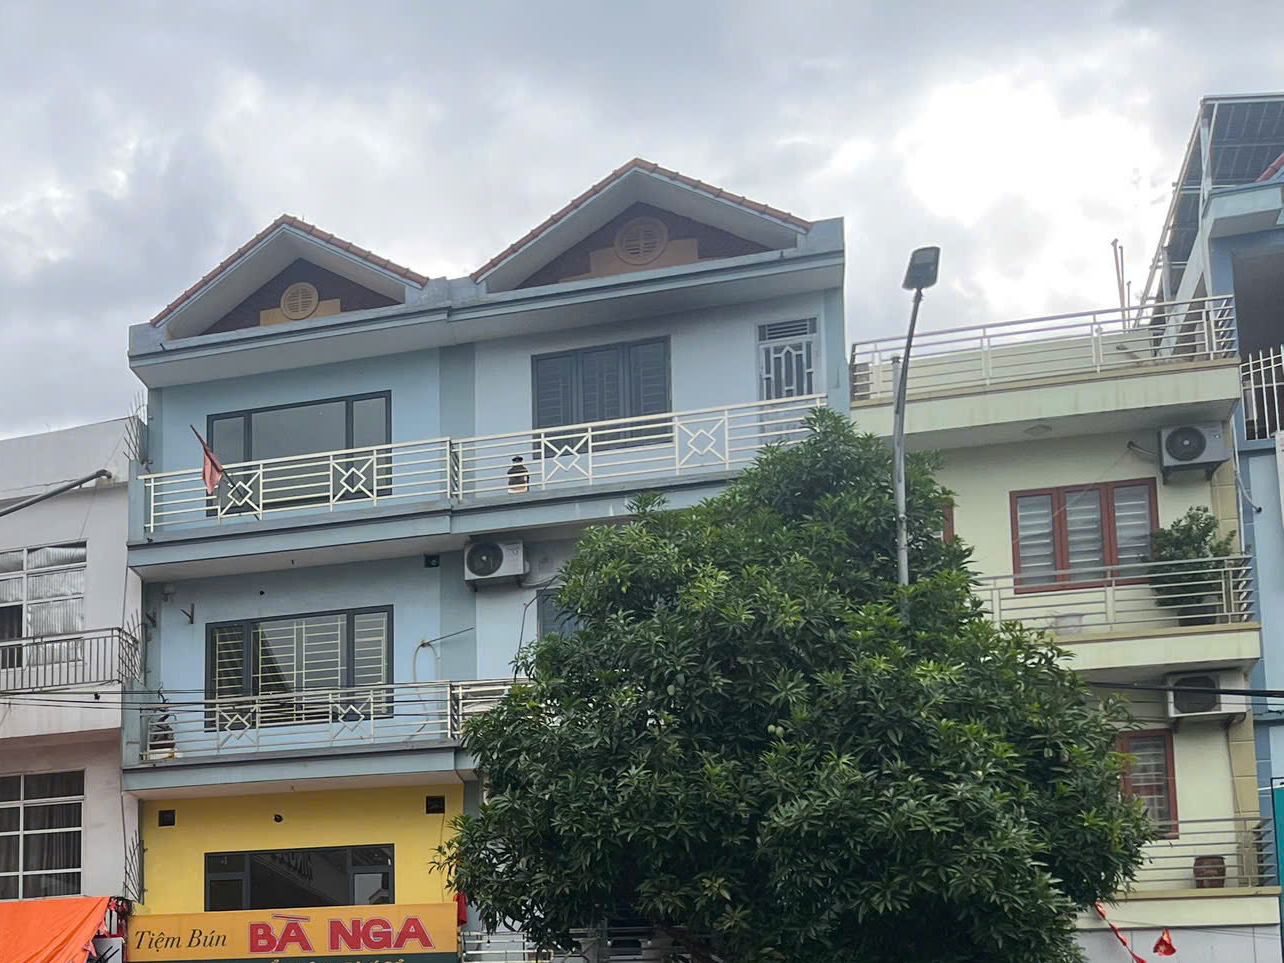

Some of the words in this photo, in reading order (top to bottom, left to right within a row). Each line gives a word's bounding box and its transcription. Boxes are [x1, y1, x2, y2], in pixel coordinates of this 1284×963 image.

[135, 930, 181, 952] Tiệm
[187, 928, 227, 949] Bún
[249, 913, 316, 954] BÀ
[328, 916, 435, 952] NGA
